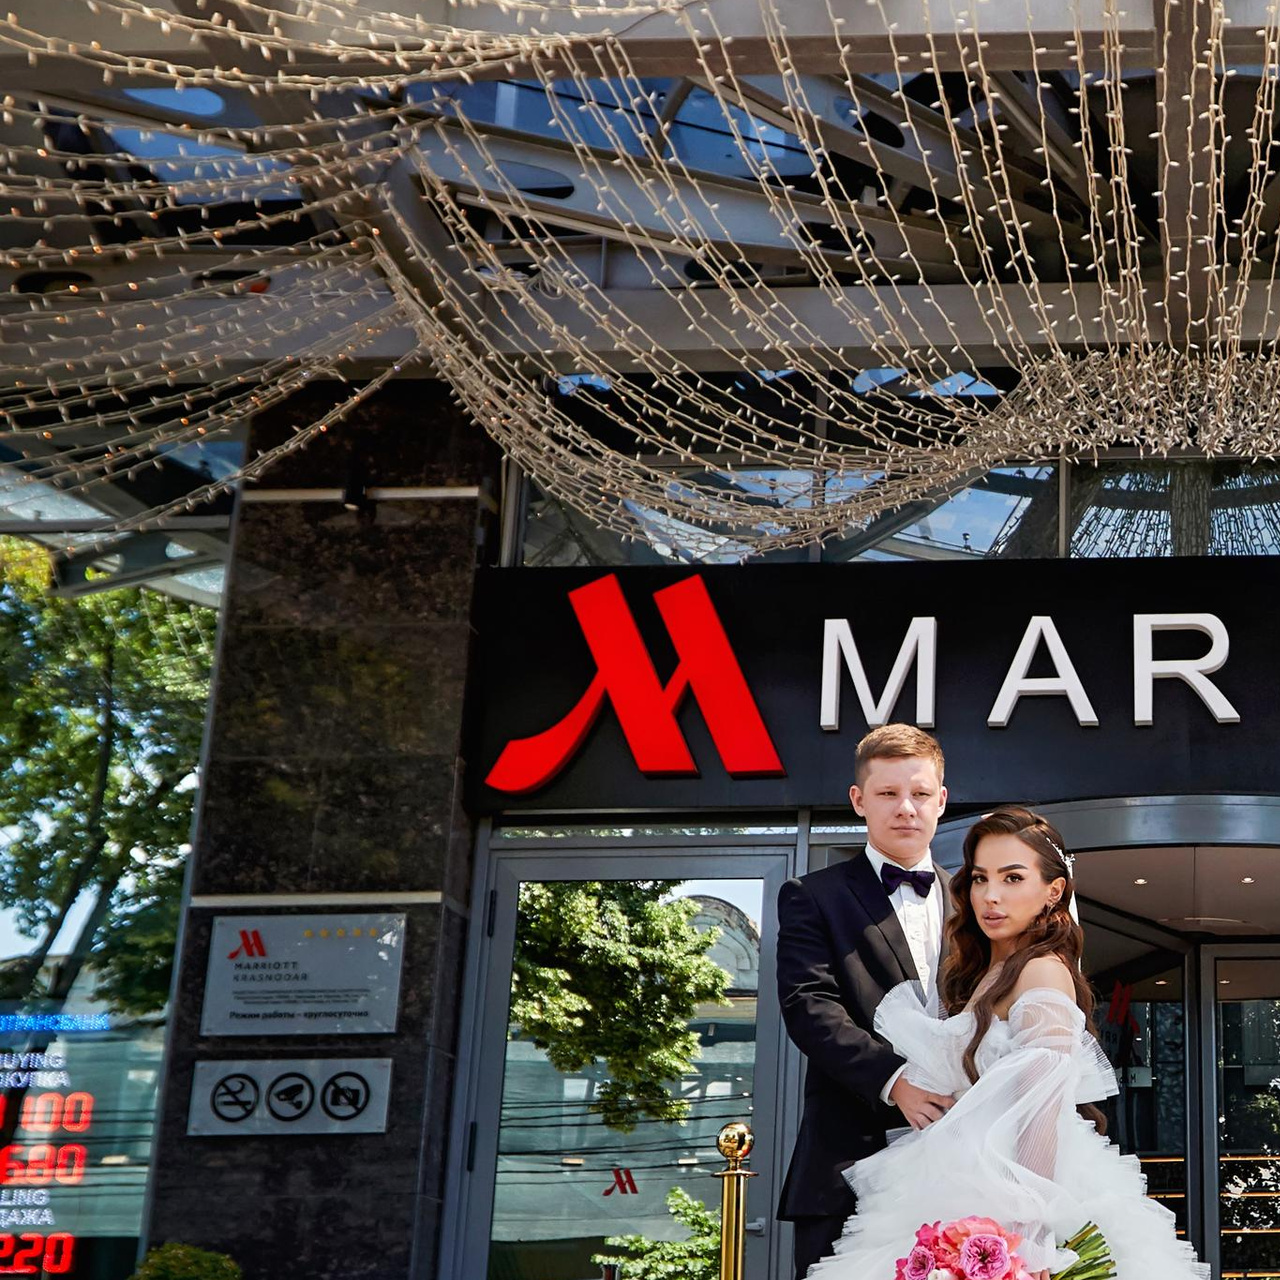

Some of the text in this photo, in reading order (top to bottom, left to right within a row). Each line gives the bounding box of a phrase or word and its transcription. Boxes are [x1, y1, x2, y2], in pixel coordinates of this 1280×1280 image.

[233, 961, 299, 970] MARRIOTT
[232, 973, 309, 982] KRASNODAR
[0, 1189, 49, 1206] LING
